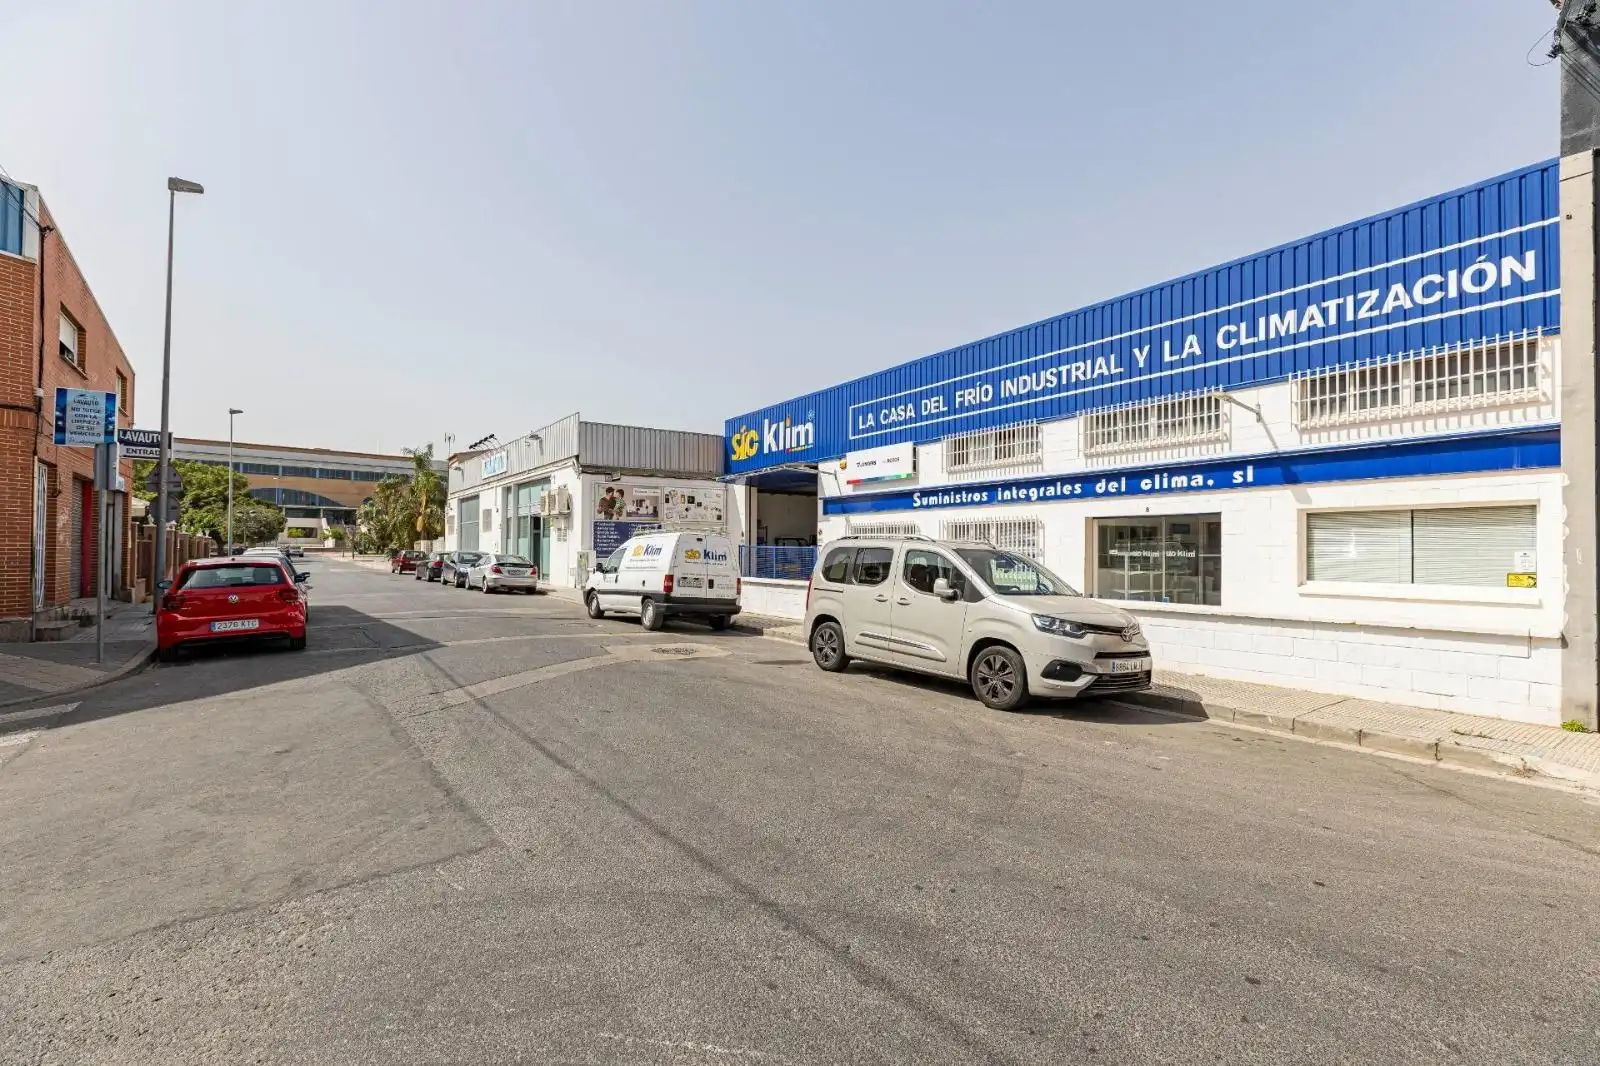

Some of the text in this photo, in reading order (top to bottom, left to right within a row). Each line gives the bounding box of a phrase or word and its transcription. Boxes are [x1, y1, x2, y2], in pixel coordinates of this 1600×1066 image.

[858, 250, 1536, 430] LA CASA DEL FRÍO INDUSTRIAL Y LA CLIMATIZACIÓN
[126, 447, 161, 456] ENTRAD
[912, 492, 988, 507] Suministros
[998, 482, 1082, 502] integrales
[1095, 476, 1126, 494] del
[1232, 465, 1254, 483] sl
